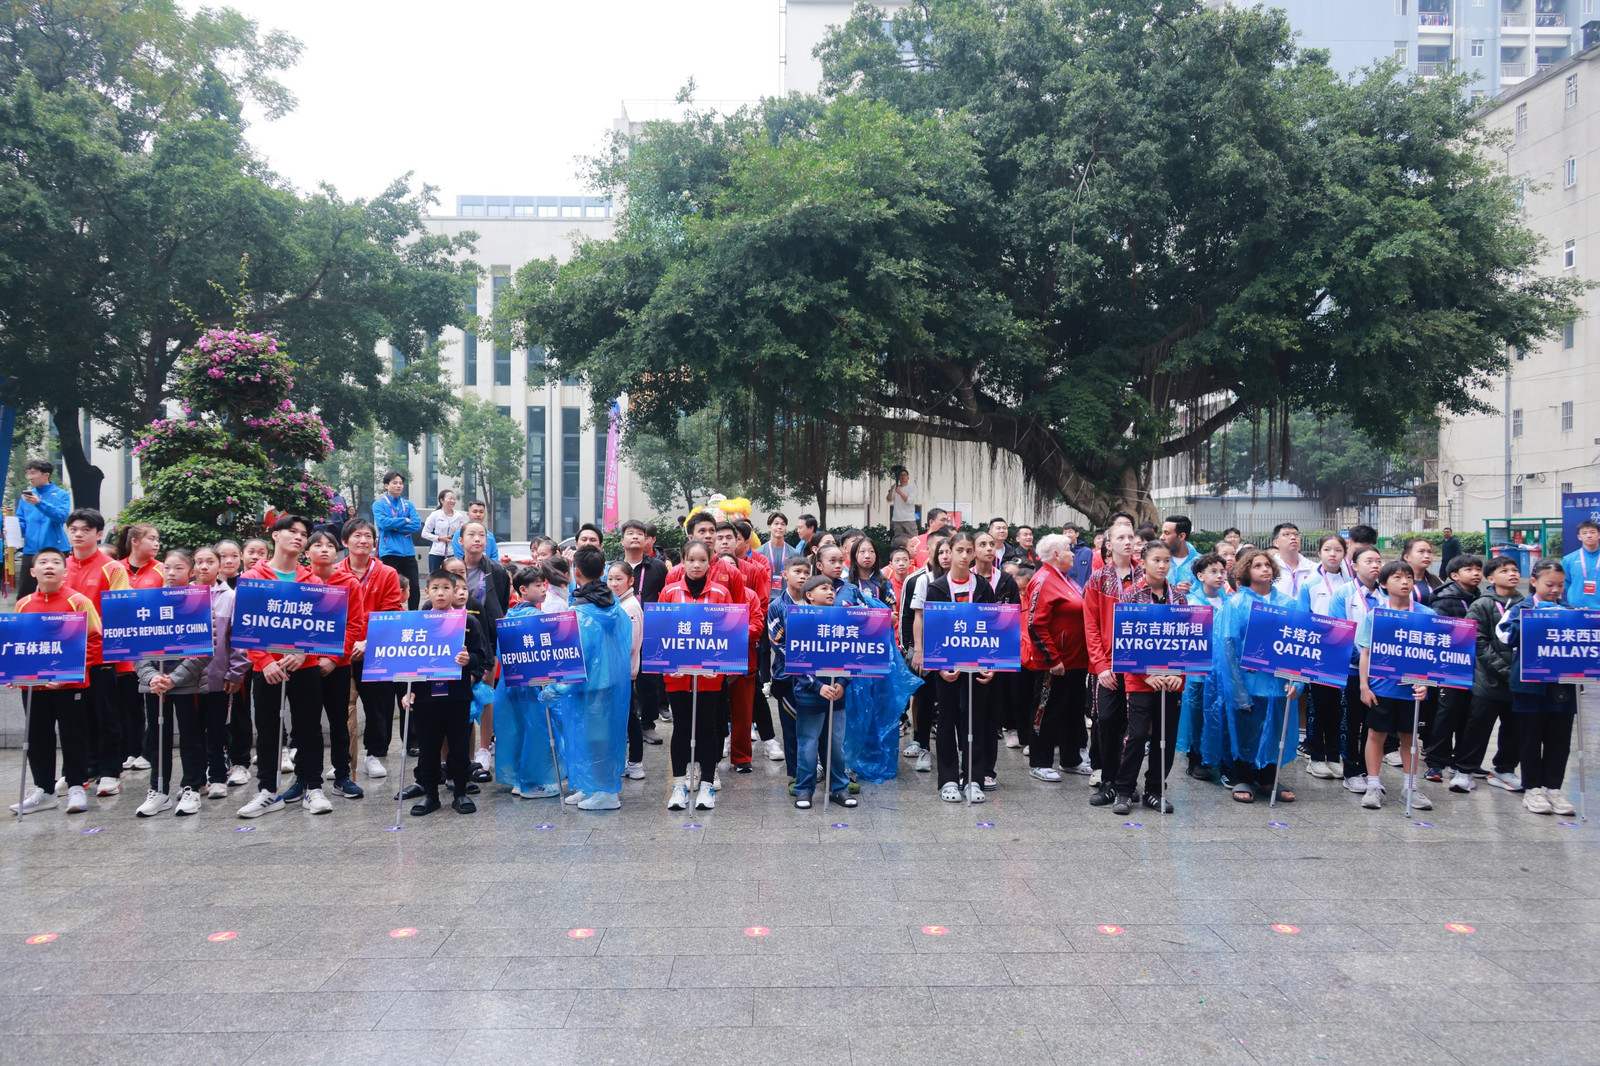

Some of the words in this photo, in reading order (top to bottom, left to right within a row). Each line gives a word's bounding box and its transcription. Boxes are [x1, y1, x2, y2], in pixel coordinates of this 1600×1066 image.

[136, 606, 174, 621] 中国
[267, 598, 313, 616] 新加坡
[103, 627, 138, 638] PEOPLE'S
[139, 625, 174, 637] REPUBLIC
[175, 624, 184, 634] OF
[186, 623, 208, 634] CHINA
[241, 614, 336, 632] SINGAPORE
[677, 621, 713, 636] 越南
[954, 620, 988, 634] 约旦
[1121, 621, 1204, 636] 吉尔吉斯斯坦
[401, 628, 428, 643] 蒙古
[817, 624, 859, 639] 菲律宾
[1278, 625, 1322, 645] 卡塔尔
[1394, 628, 1452, 648] 中国香港
[1546, 628, 1600, 643] 马来西亚
[522, 632, 552, 648] 韩国
[661, 637, 728, 650] VIETNAM
[790, 640, 885, 655] PHILIPPINES
[942, 636, 1000, 648] JORDAN
[1115, 637, 1208, 651] KYRGYZSTAN
[1, 641, 63, 656] 广西体操队
[374, 644, 452, 658] MONGOLIA
[501, 650, 540, 665] REPUBLIC
[540, 649, 552, 662] OF
[552, 646, 581, 660] KOREA
[1273, 640, 1322, 661] QATAR
[1372, 642, 1402, 657] HONG
[1404, 646, 1437, 664] KONG,
[1439, 650, 1472, 666] CHINA
